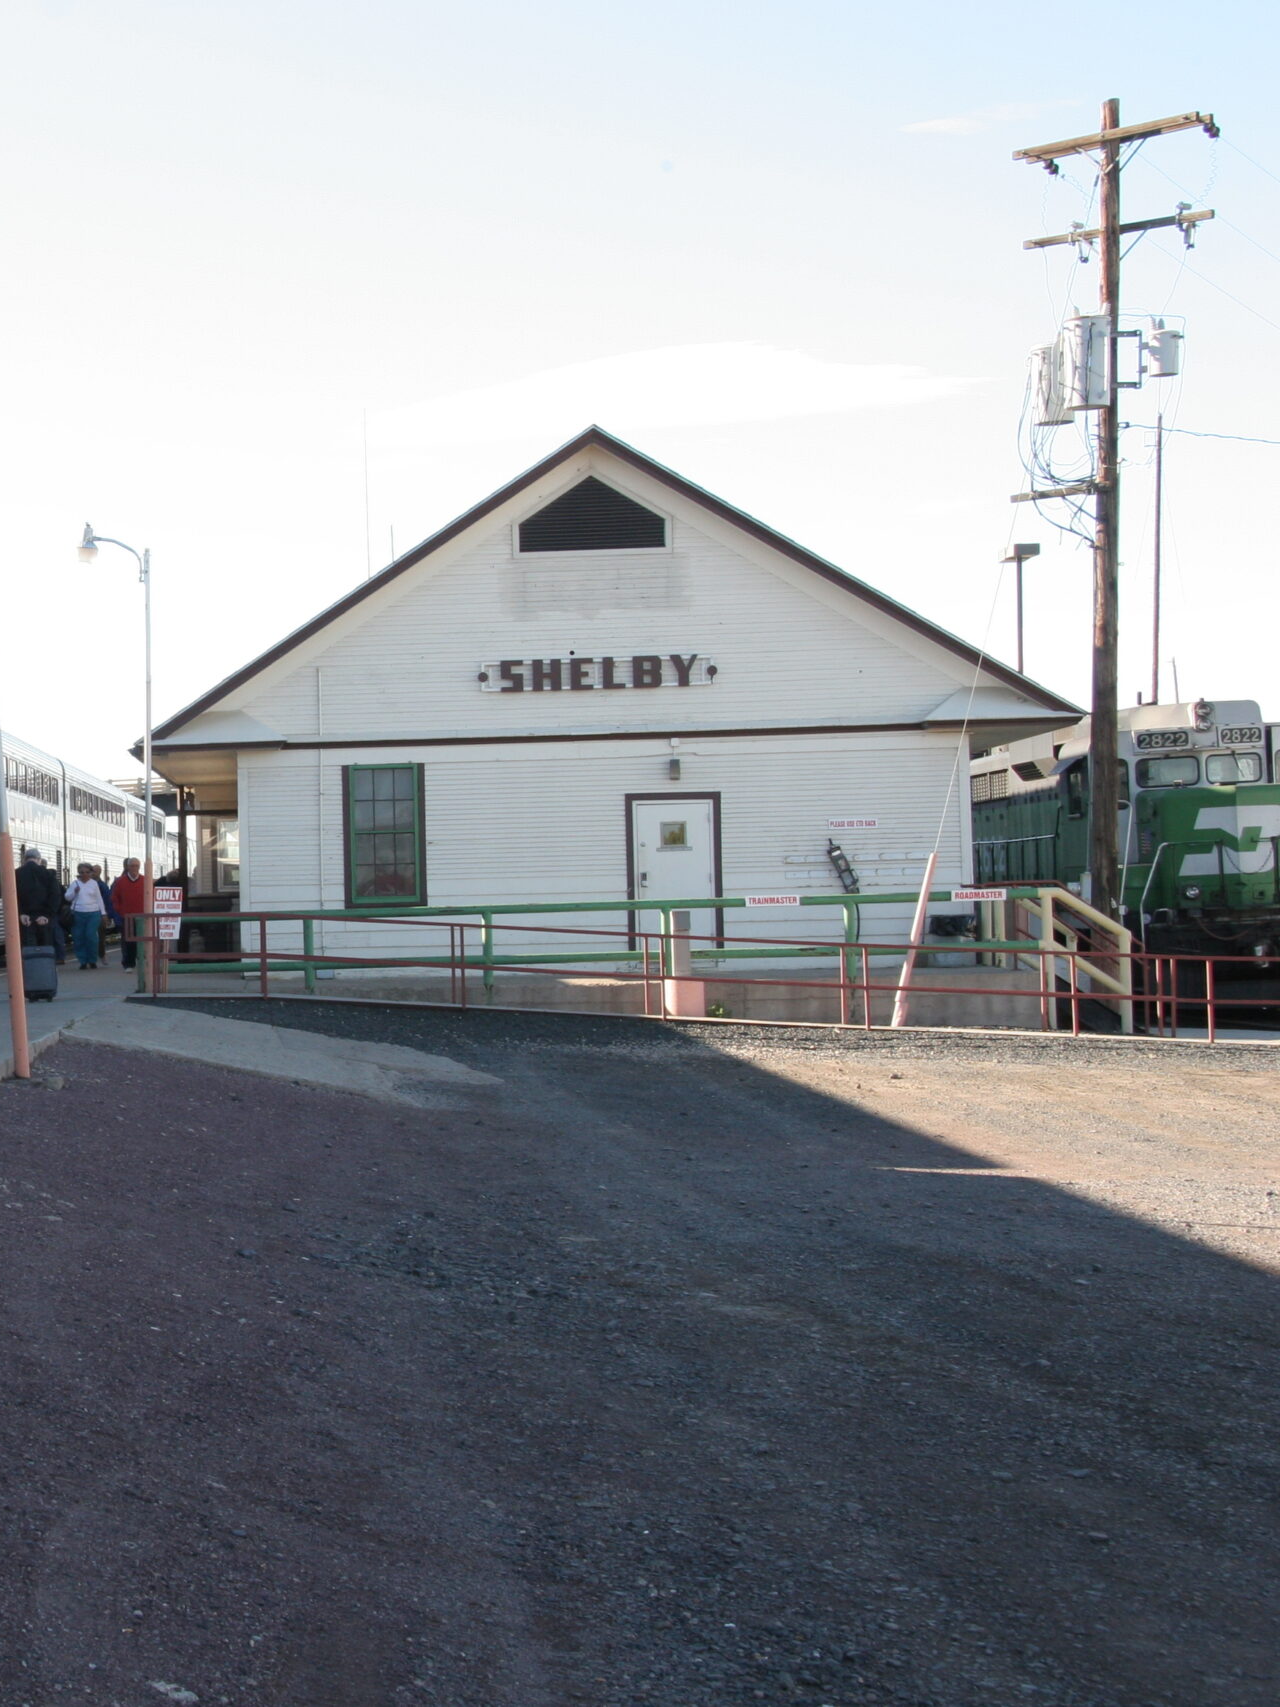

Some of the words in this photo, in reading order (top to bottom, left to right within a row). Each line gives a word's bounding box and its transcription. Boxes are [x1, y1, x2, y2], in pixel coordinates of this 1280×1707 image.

[500, 654, 698, 692] SHELBY
[1139, 732, 1187, 748] 2822
[1222, 728, 1260, 743] 2822
[156, 889, 181, 901] ONLY
[748, 895, 798, 905] TRAINMASTER
[954, 890, 1003, 900] ROADMASTER
